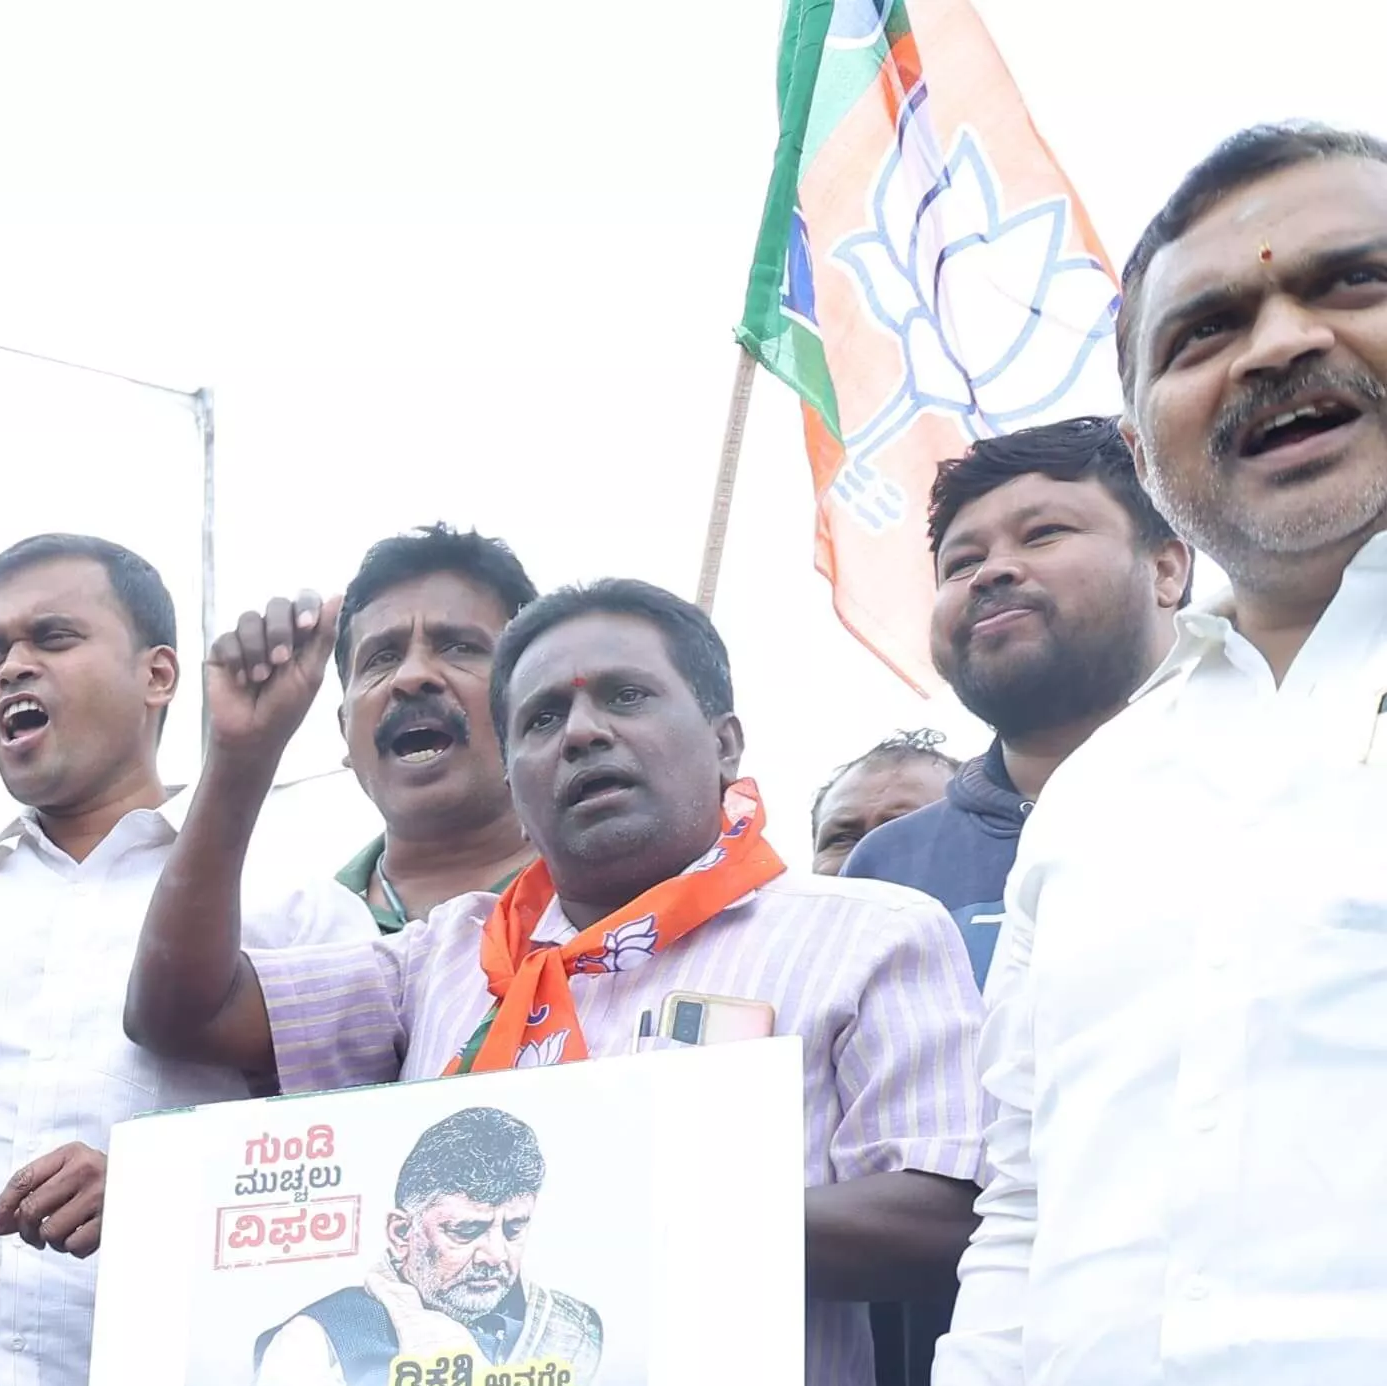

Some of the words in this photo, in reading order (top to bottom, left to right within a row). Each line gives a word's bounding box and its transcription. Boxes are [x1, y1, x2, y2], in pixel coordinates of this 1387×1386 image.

[245, 1124, 335, 1165] ಗುಂಡಿ
[235, 1163, 342, 1203] ಮುಚ್ಚಲು
[228, 1208, 347, 1254] ವಿಫಲ
